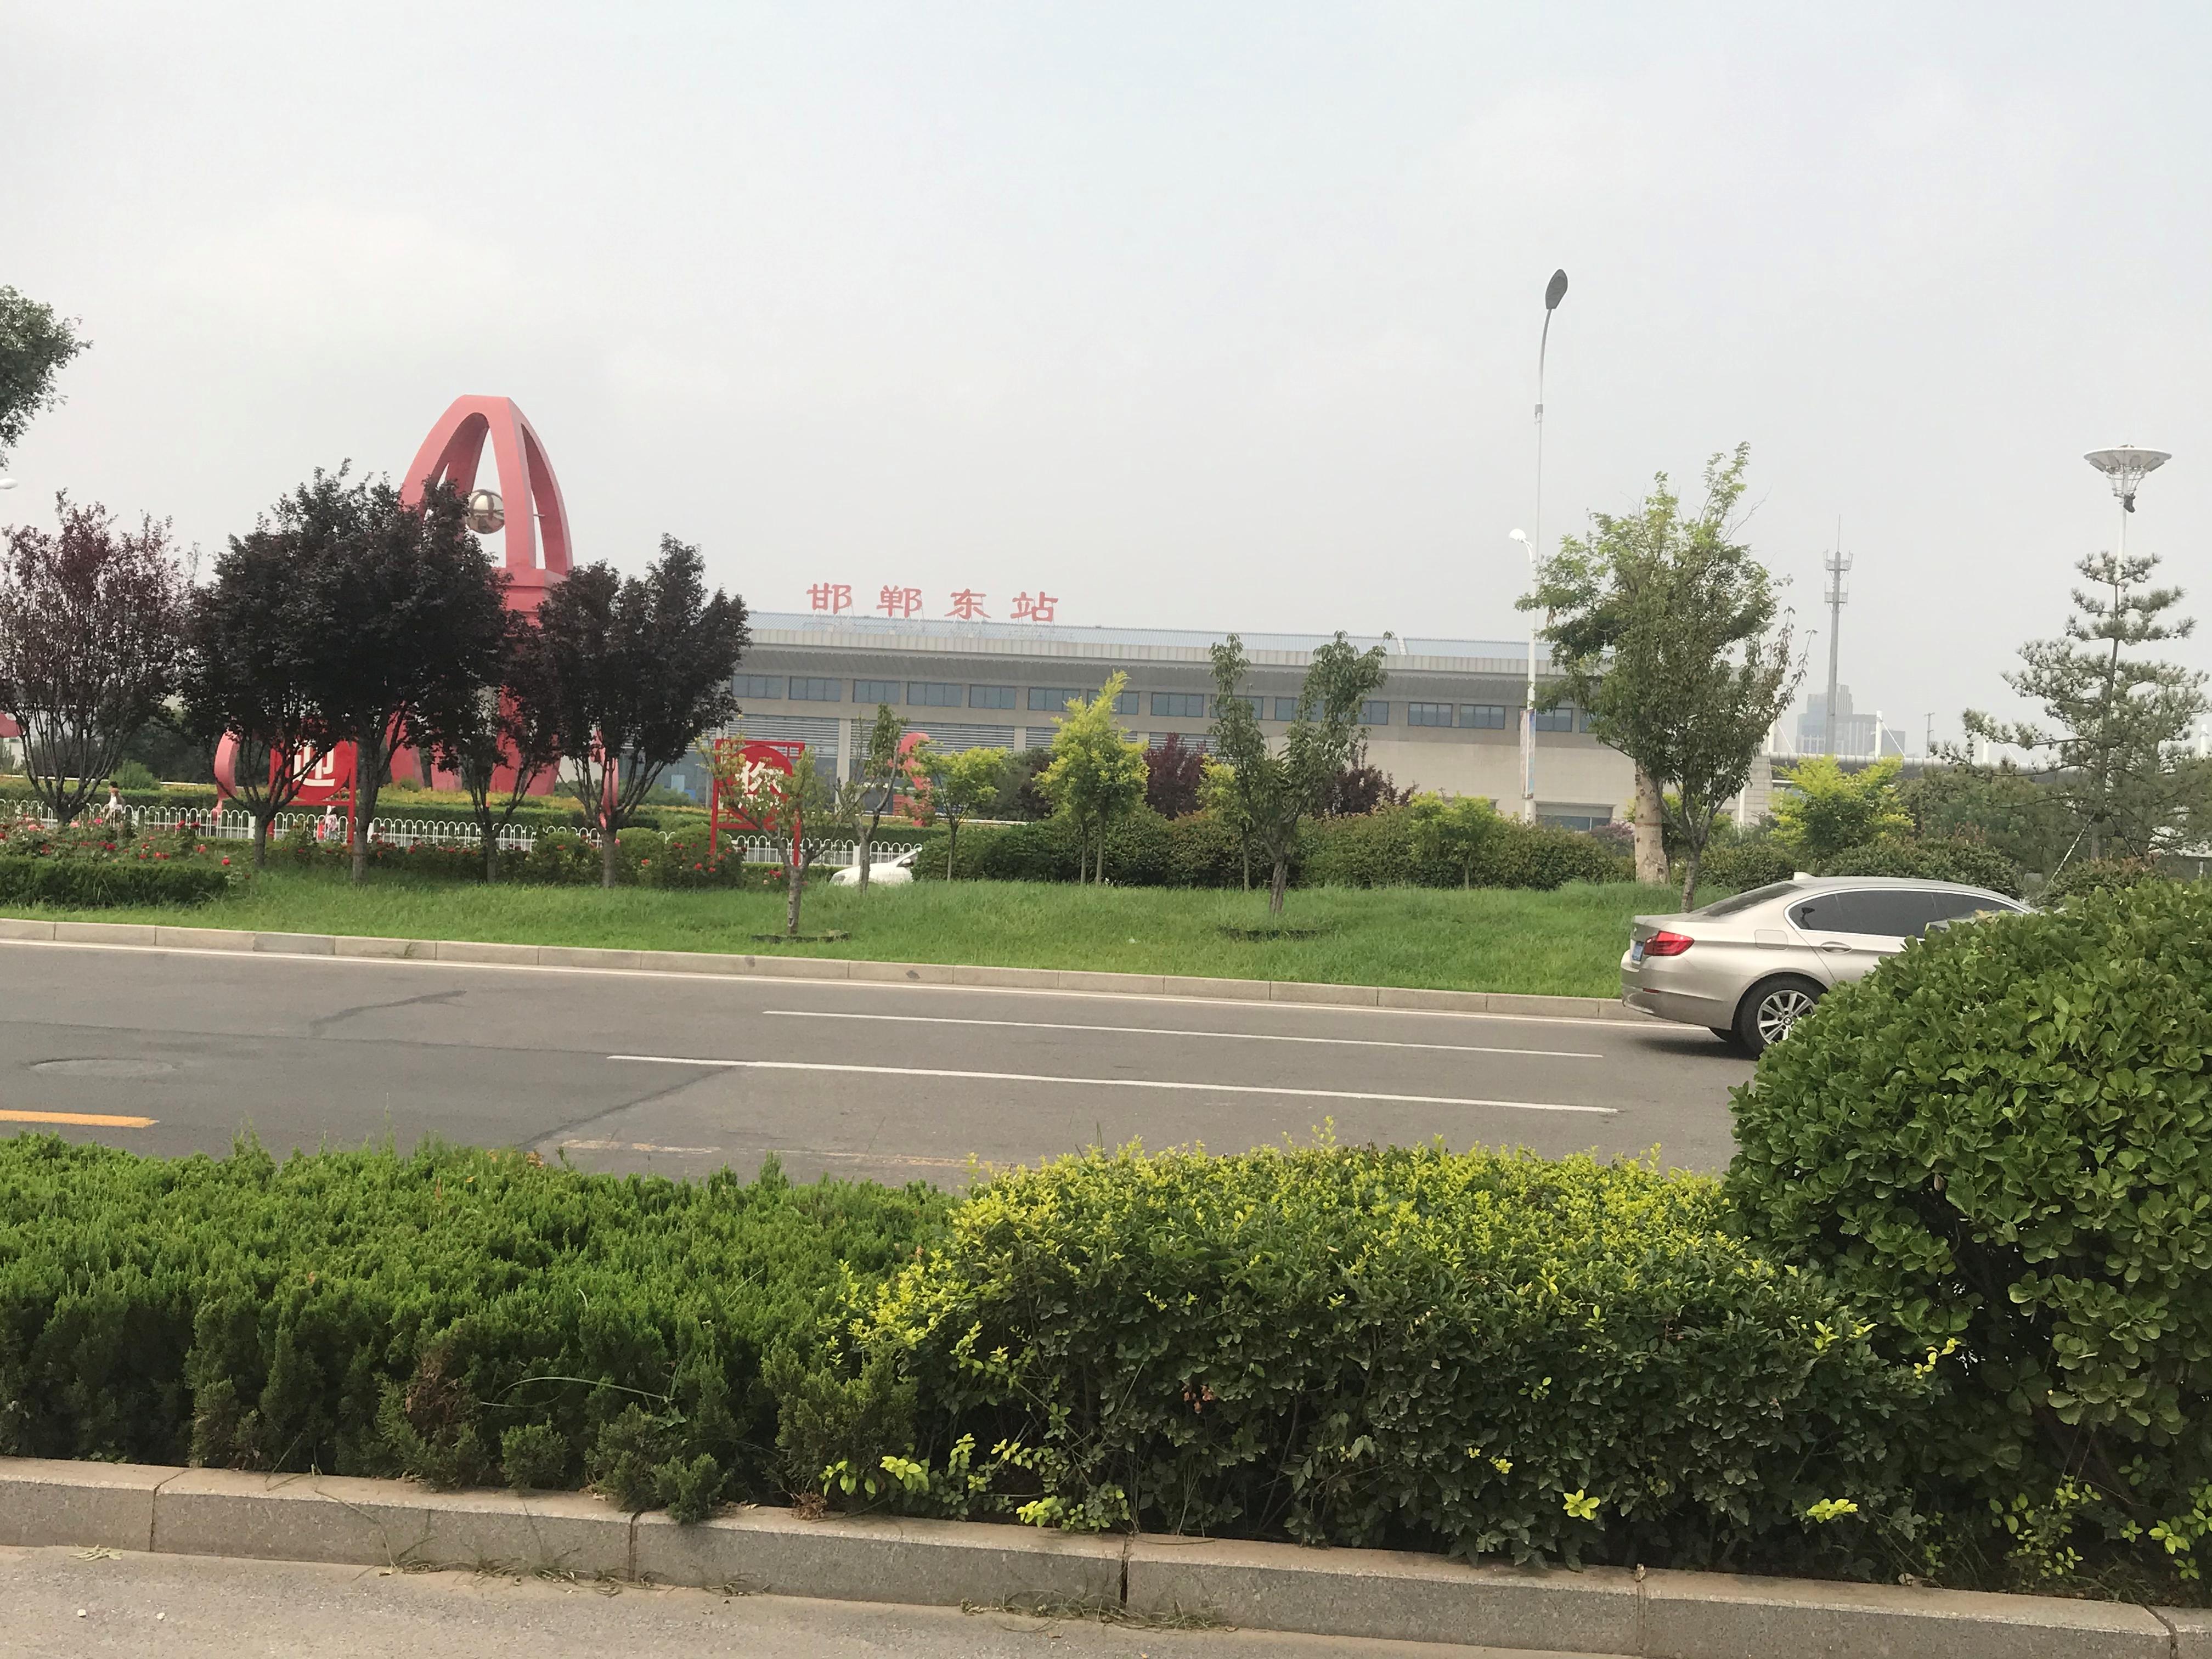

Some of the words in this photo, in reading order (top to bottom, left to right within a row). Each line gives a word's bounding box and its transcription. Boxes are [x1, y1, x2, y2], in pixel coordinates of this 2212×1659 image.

[806, 582, 1058, 622] 邯郸东站
[292, 740, 336, 787] 迎
